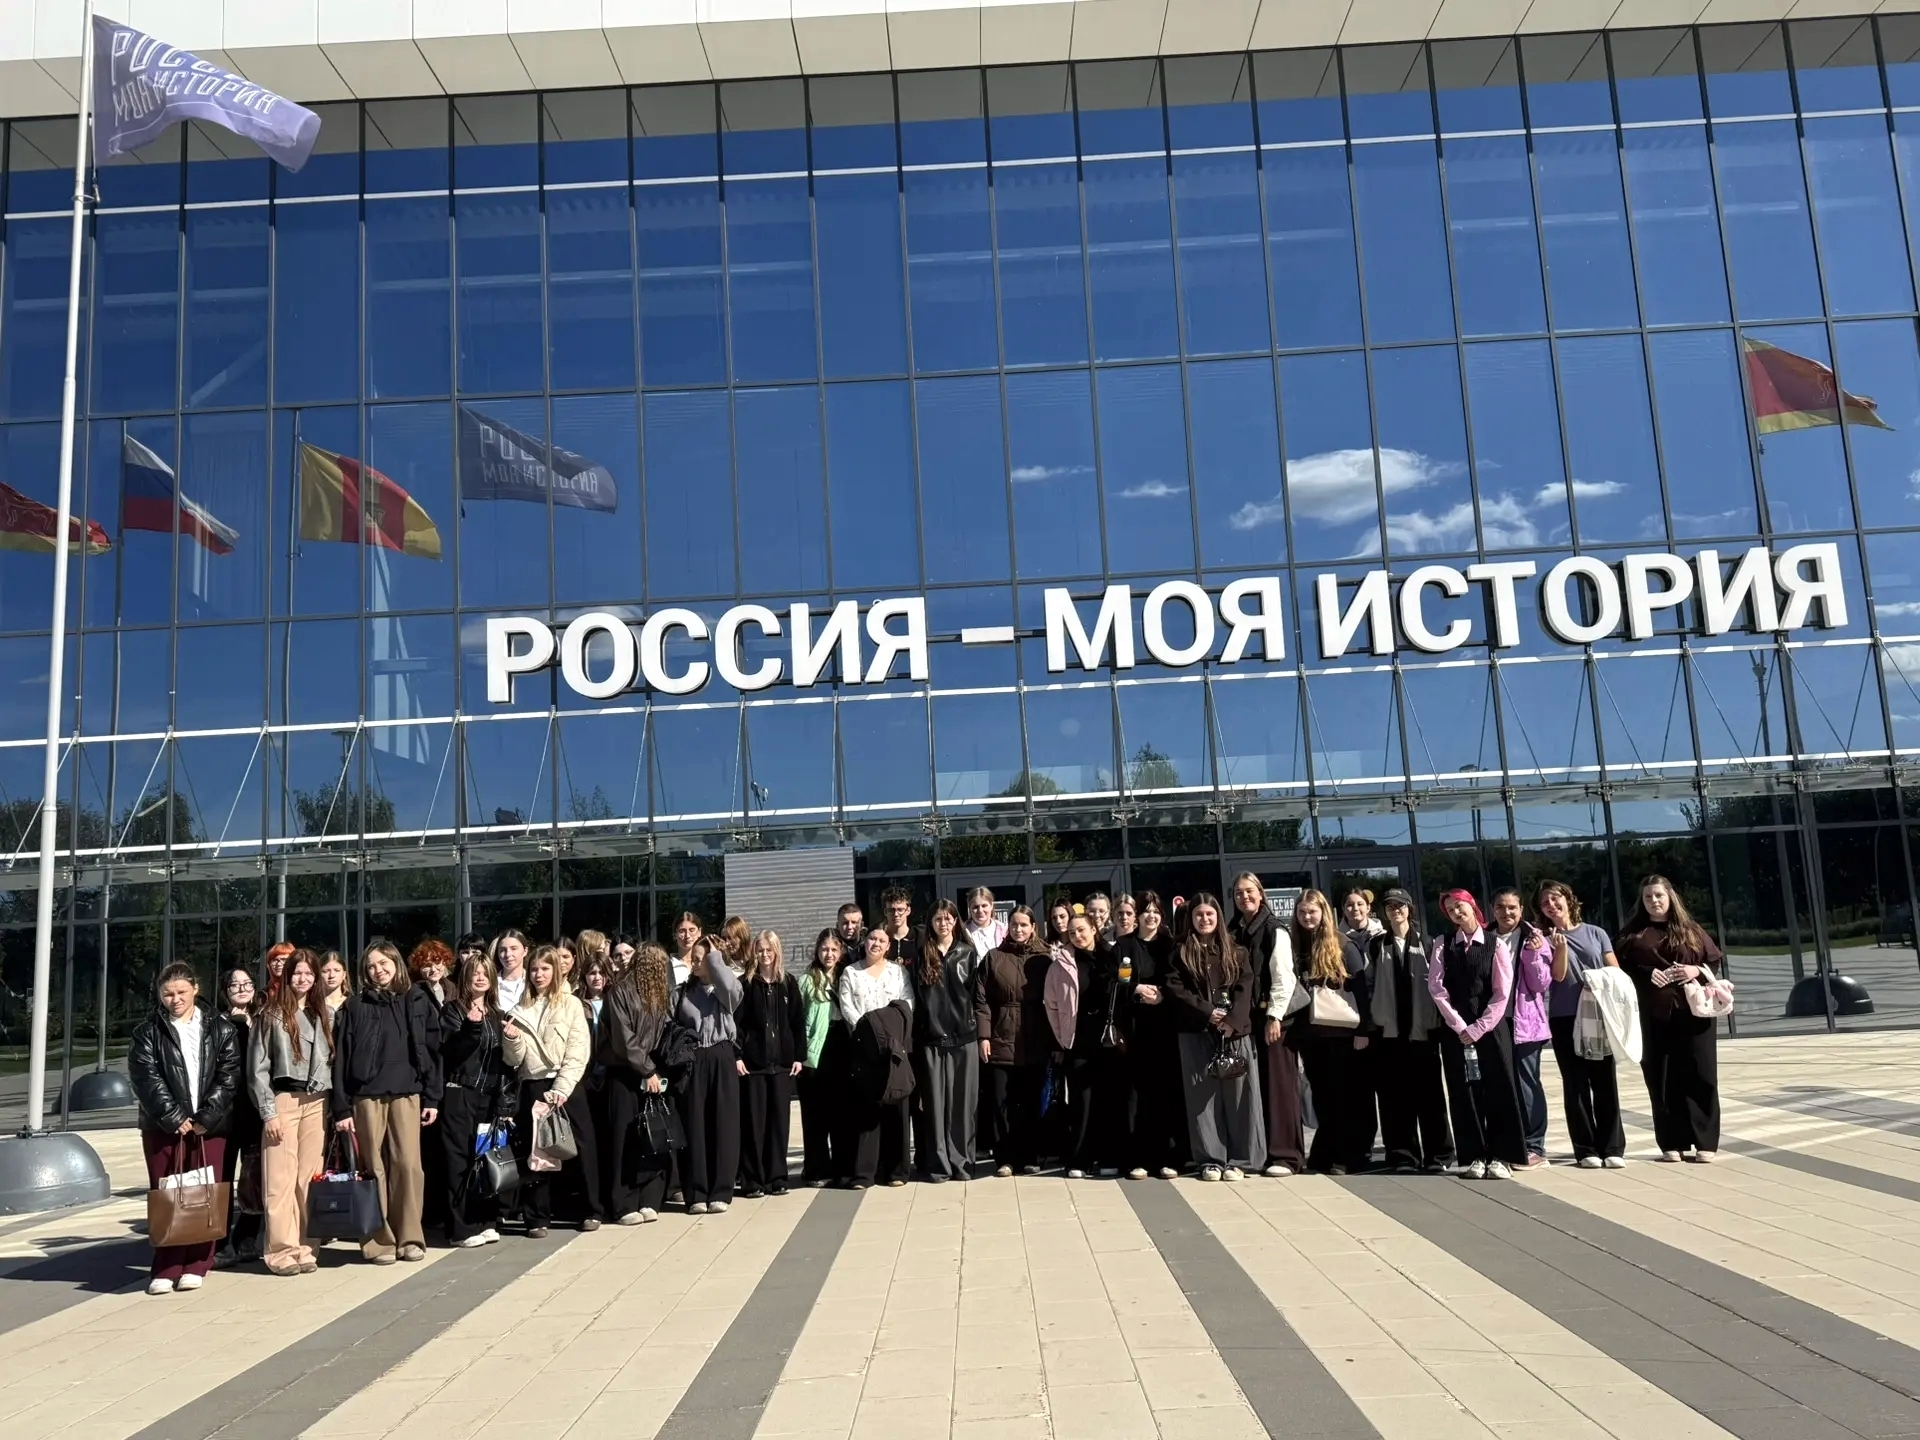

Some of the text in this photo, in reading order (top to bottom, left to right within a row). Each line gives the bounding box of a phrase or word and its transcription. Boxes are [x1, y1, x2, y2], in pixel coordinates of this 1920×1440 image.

[113, 71, 279, 126] МОЯ ИСТОРИЯ
[486, 597, 928, 703] РОССИЯ
[1044, 576, 1285, 672] МОЯ
[1317, 542, 1848, 658] ИСТОРИЯ
